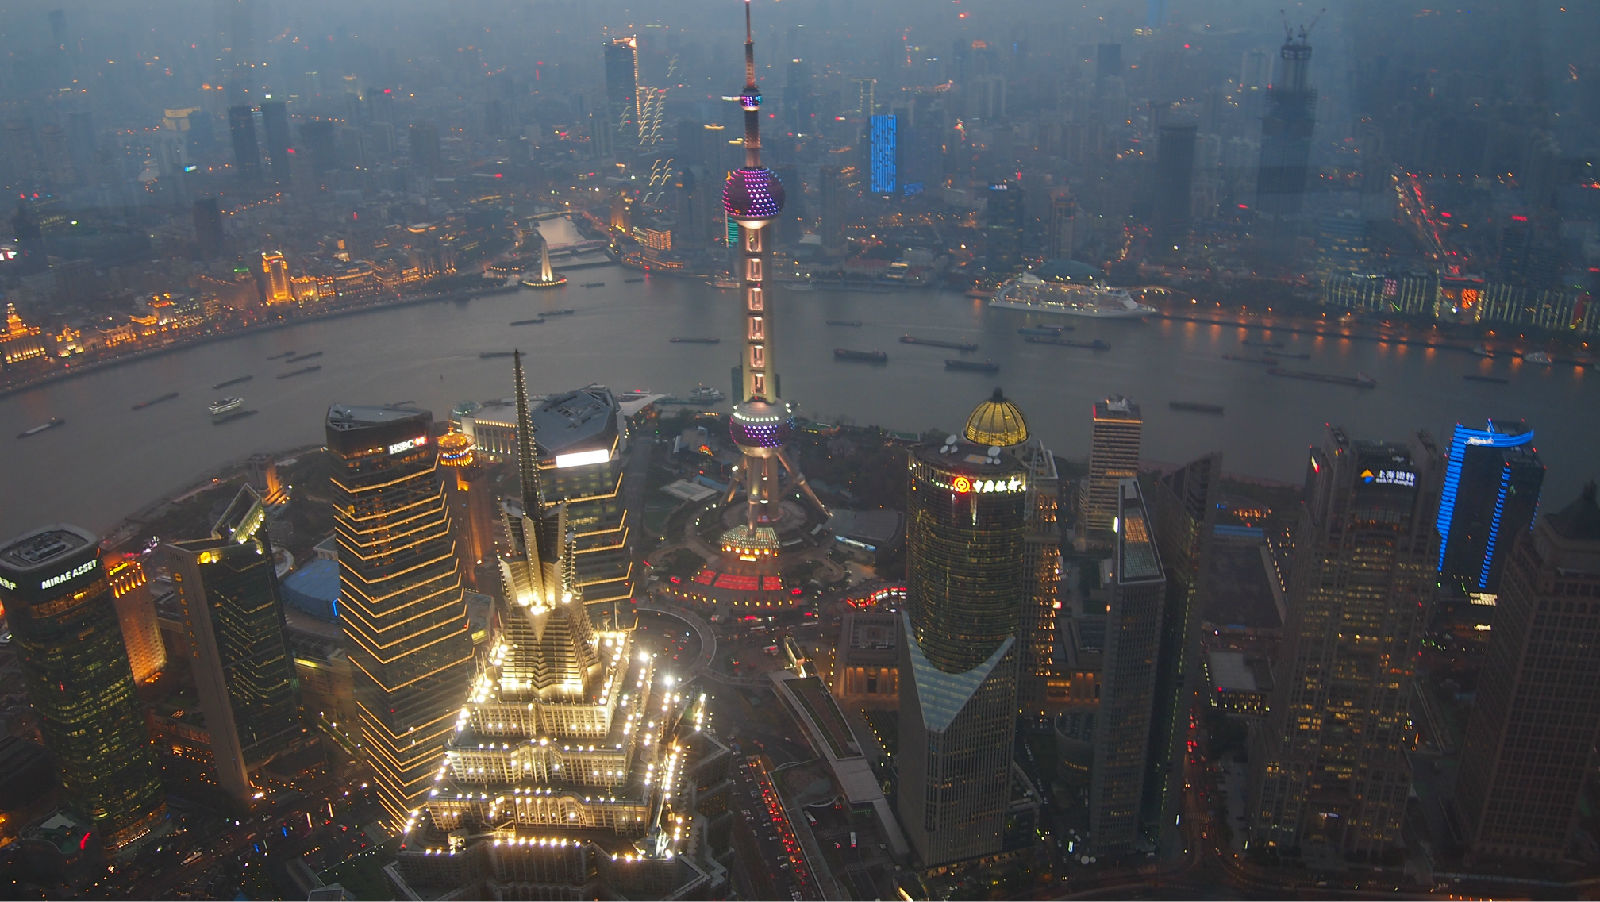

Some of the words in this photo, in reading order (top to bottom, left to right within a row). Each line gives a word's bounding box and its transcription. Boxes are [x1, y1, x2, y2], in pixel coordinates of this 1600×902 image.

[390, 440, 414, 454] HSBC
[41, 571, 71, 589] MIRAE
[72, 559, 97, 577] ASSET
